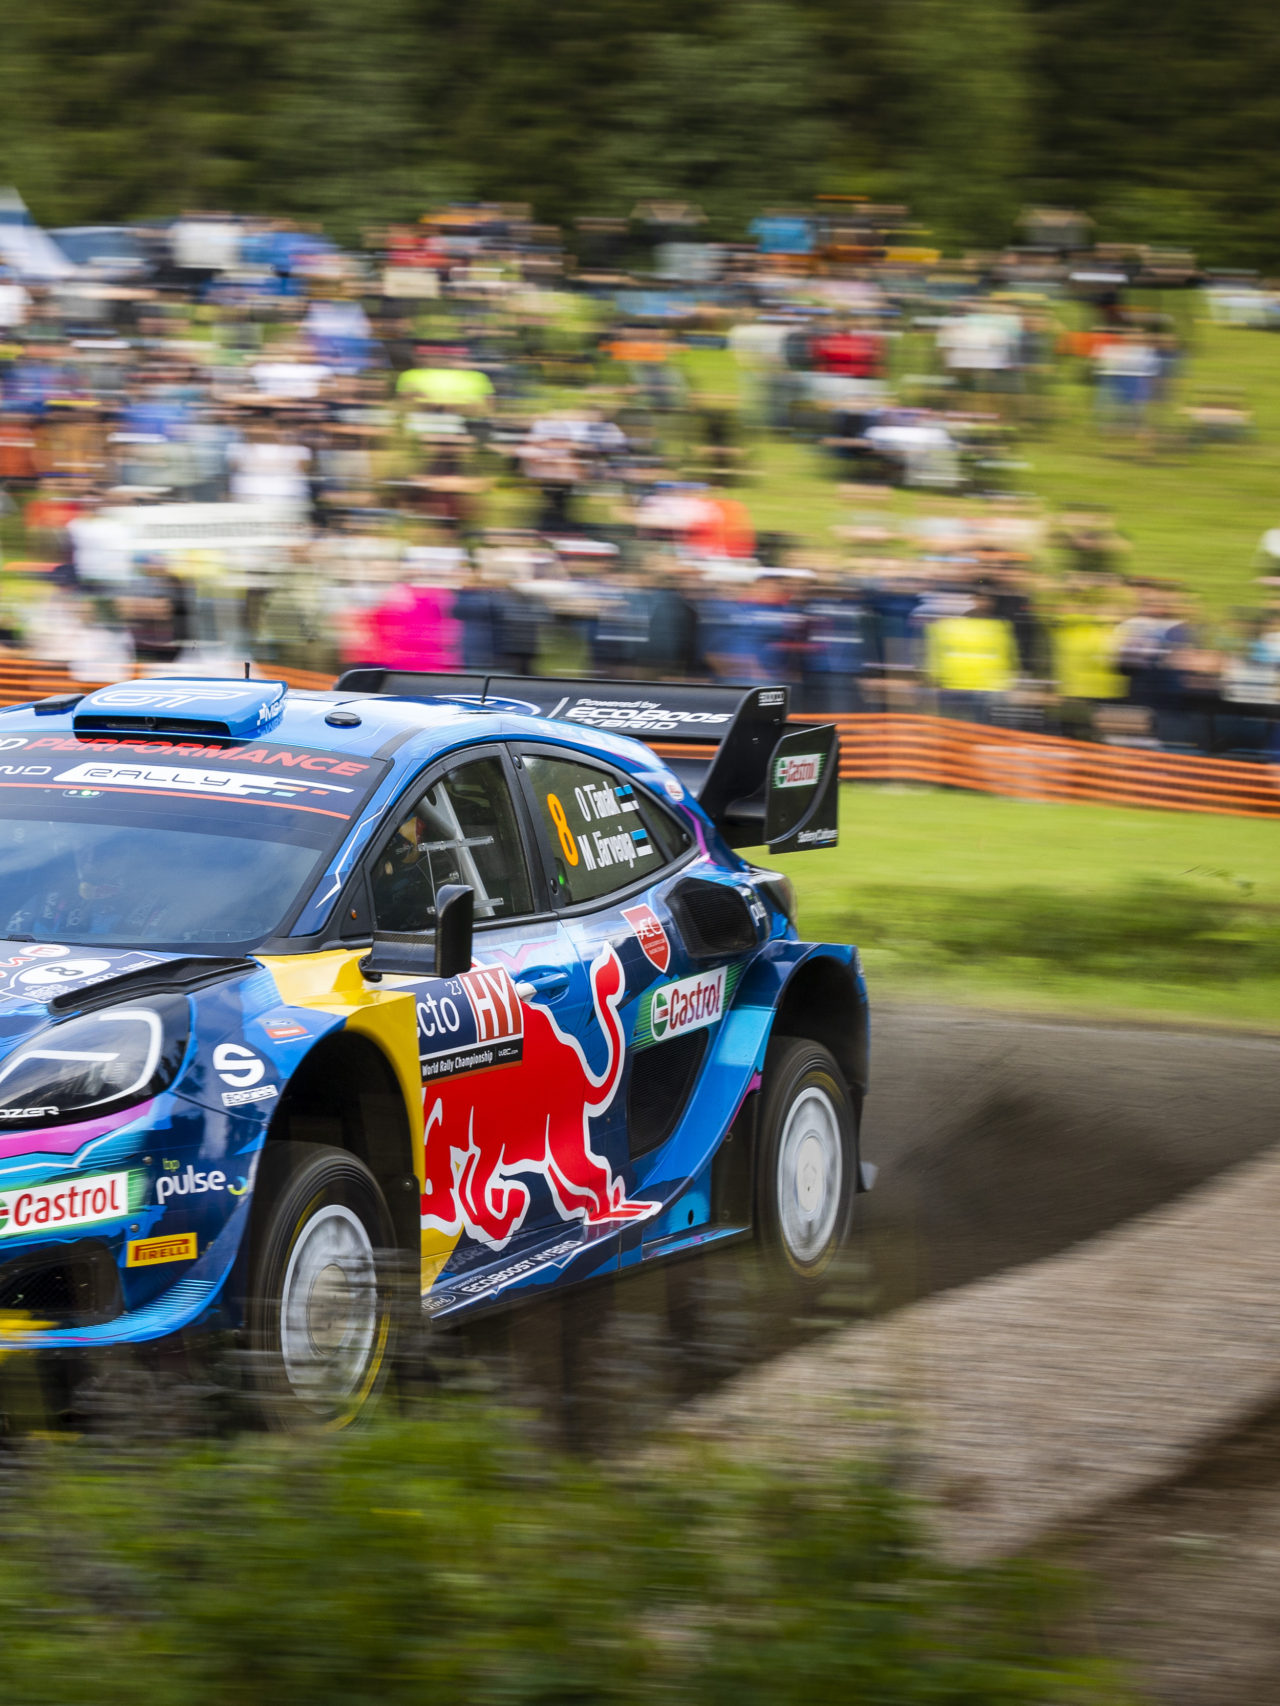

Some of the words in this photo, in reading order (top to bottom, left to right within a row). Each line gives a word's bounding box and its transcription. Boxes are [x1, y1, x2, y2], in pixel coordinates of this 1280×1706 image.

[565, 706, 735, 724] ECOBOOS
[23, 737, 370, 777] PERFORMANCE
[83, 768, 231, 787] RALLY
[547, 793, 579, 867] 8
[45, 966, 84, 977] 8
[416, 993, 460, 1038] cto
[463, 969, 514, 1040] HY
[670, 974, 722, 1030] Castrol
[422, 1061, 439, 1077] World
[439, 1058, 455, 1073] Rally
[454, 1050, 493, 1069] Championship
[162, 1157, 180, 1172] bp
[13, 1179, 119, 1227] Castrol
[156, 1165, 226, 1205] pulse
[134, 1238, 190, 1262] PIRELLI
[461, 1259, 533, 1293] ECOBOOST
